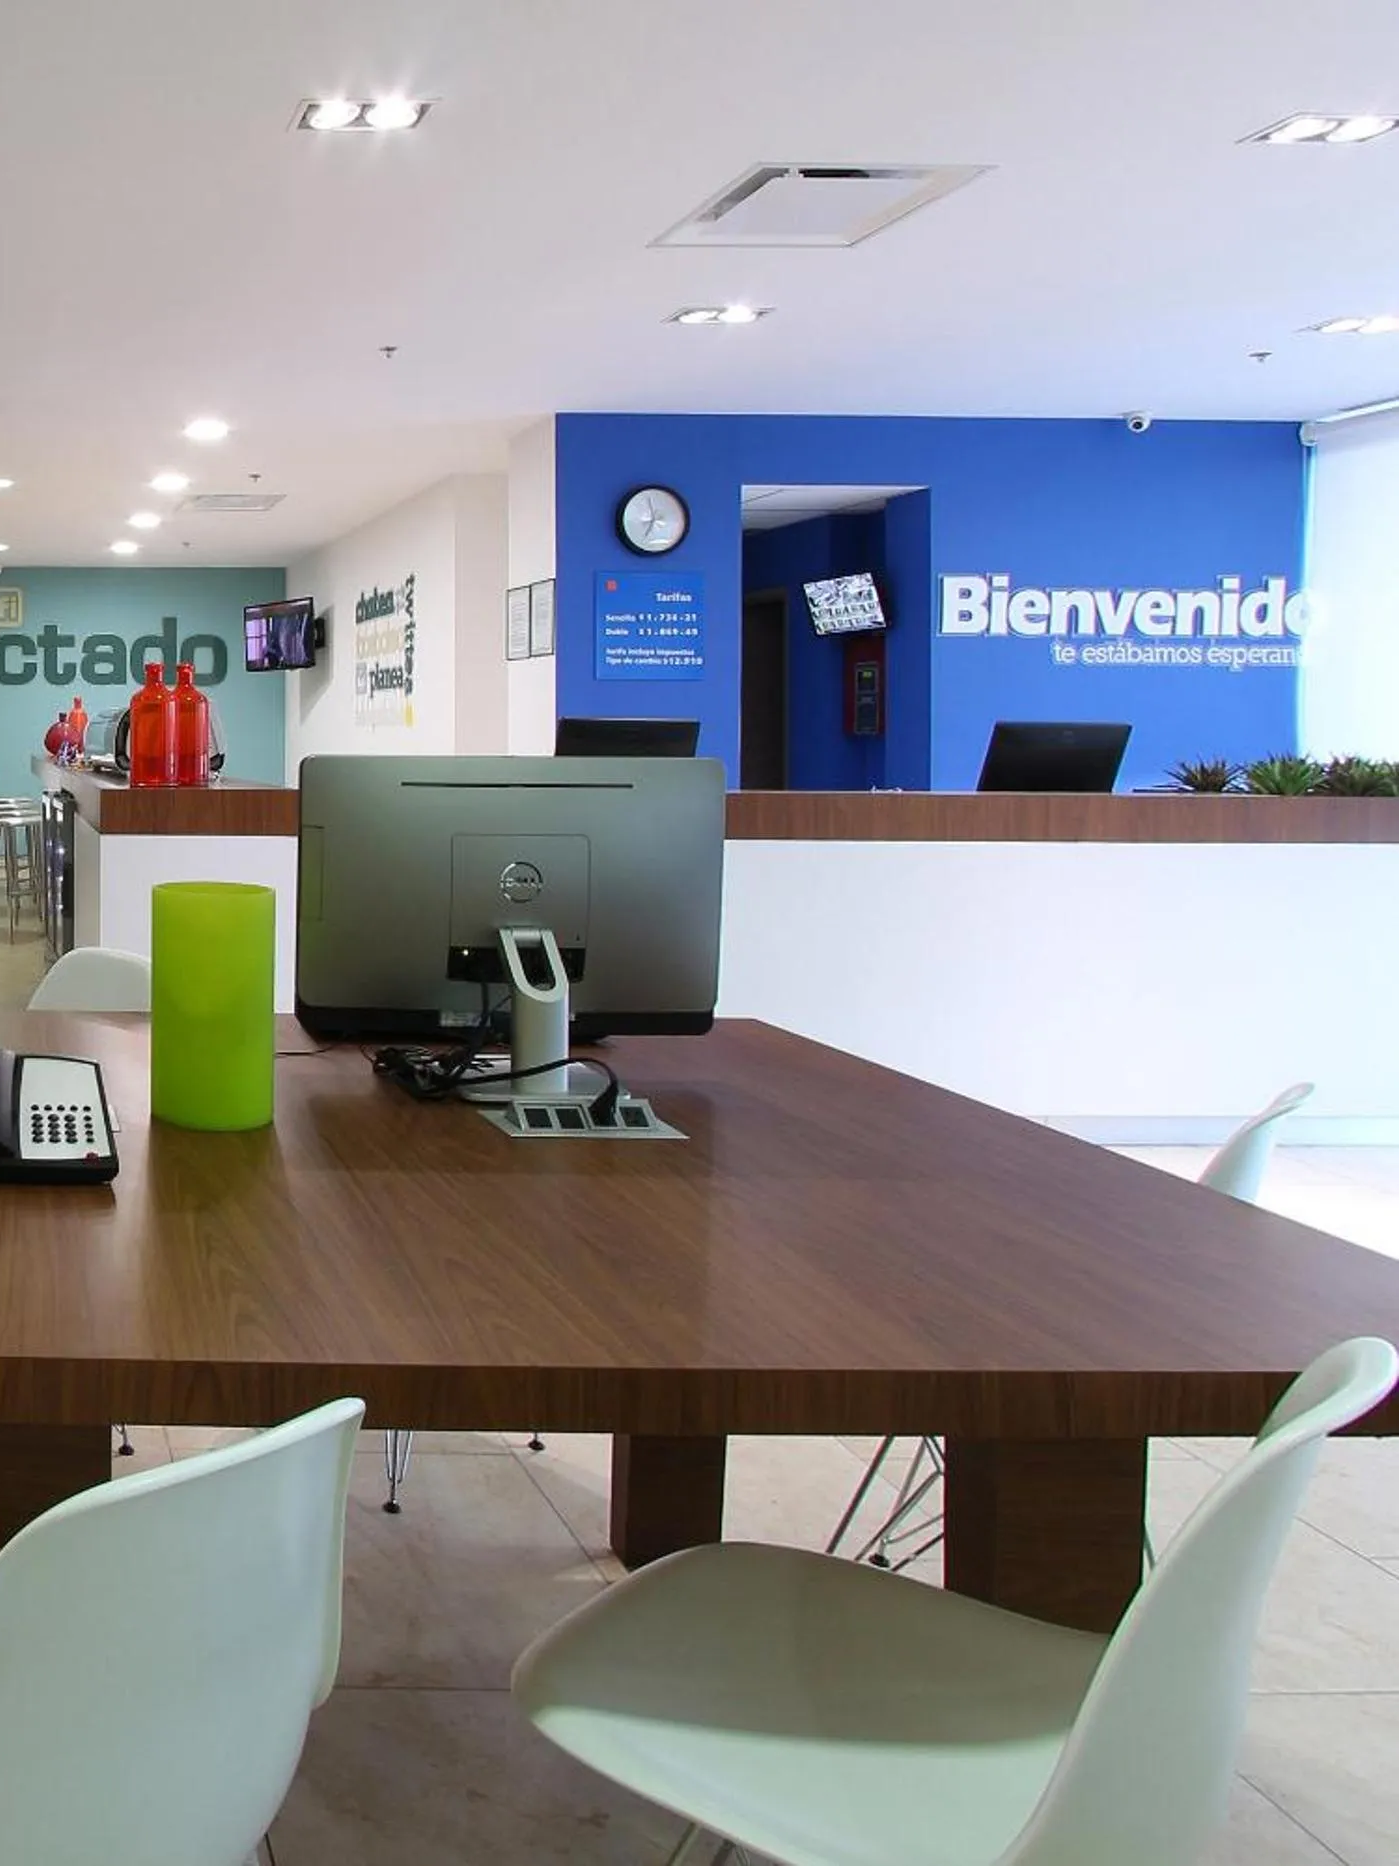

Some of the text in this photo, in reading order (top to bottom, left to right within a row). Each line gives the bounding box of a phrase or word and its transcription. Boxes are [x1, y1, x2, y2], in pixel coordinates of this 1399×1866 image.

[655, 591, 692, 602] Tarifas
[1053, 642, 1077, 664] te
[1082, 640, 1203, 665] estábamos
[369, 661, 404, 699] planea
